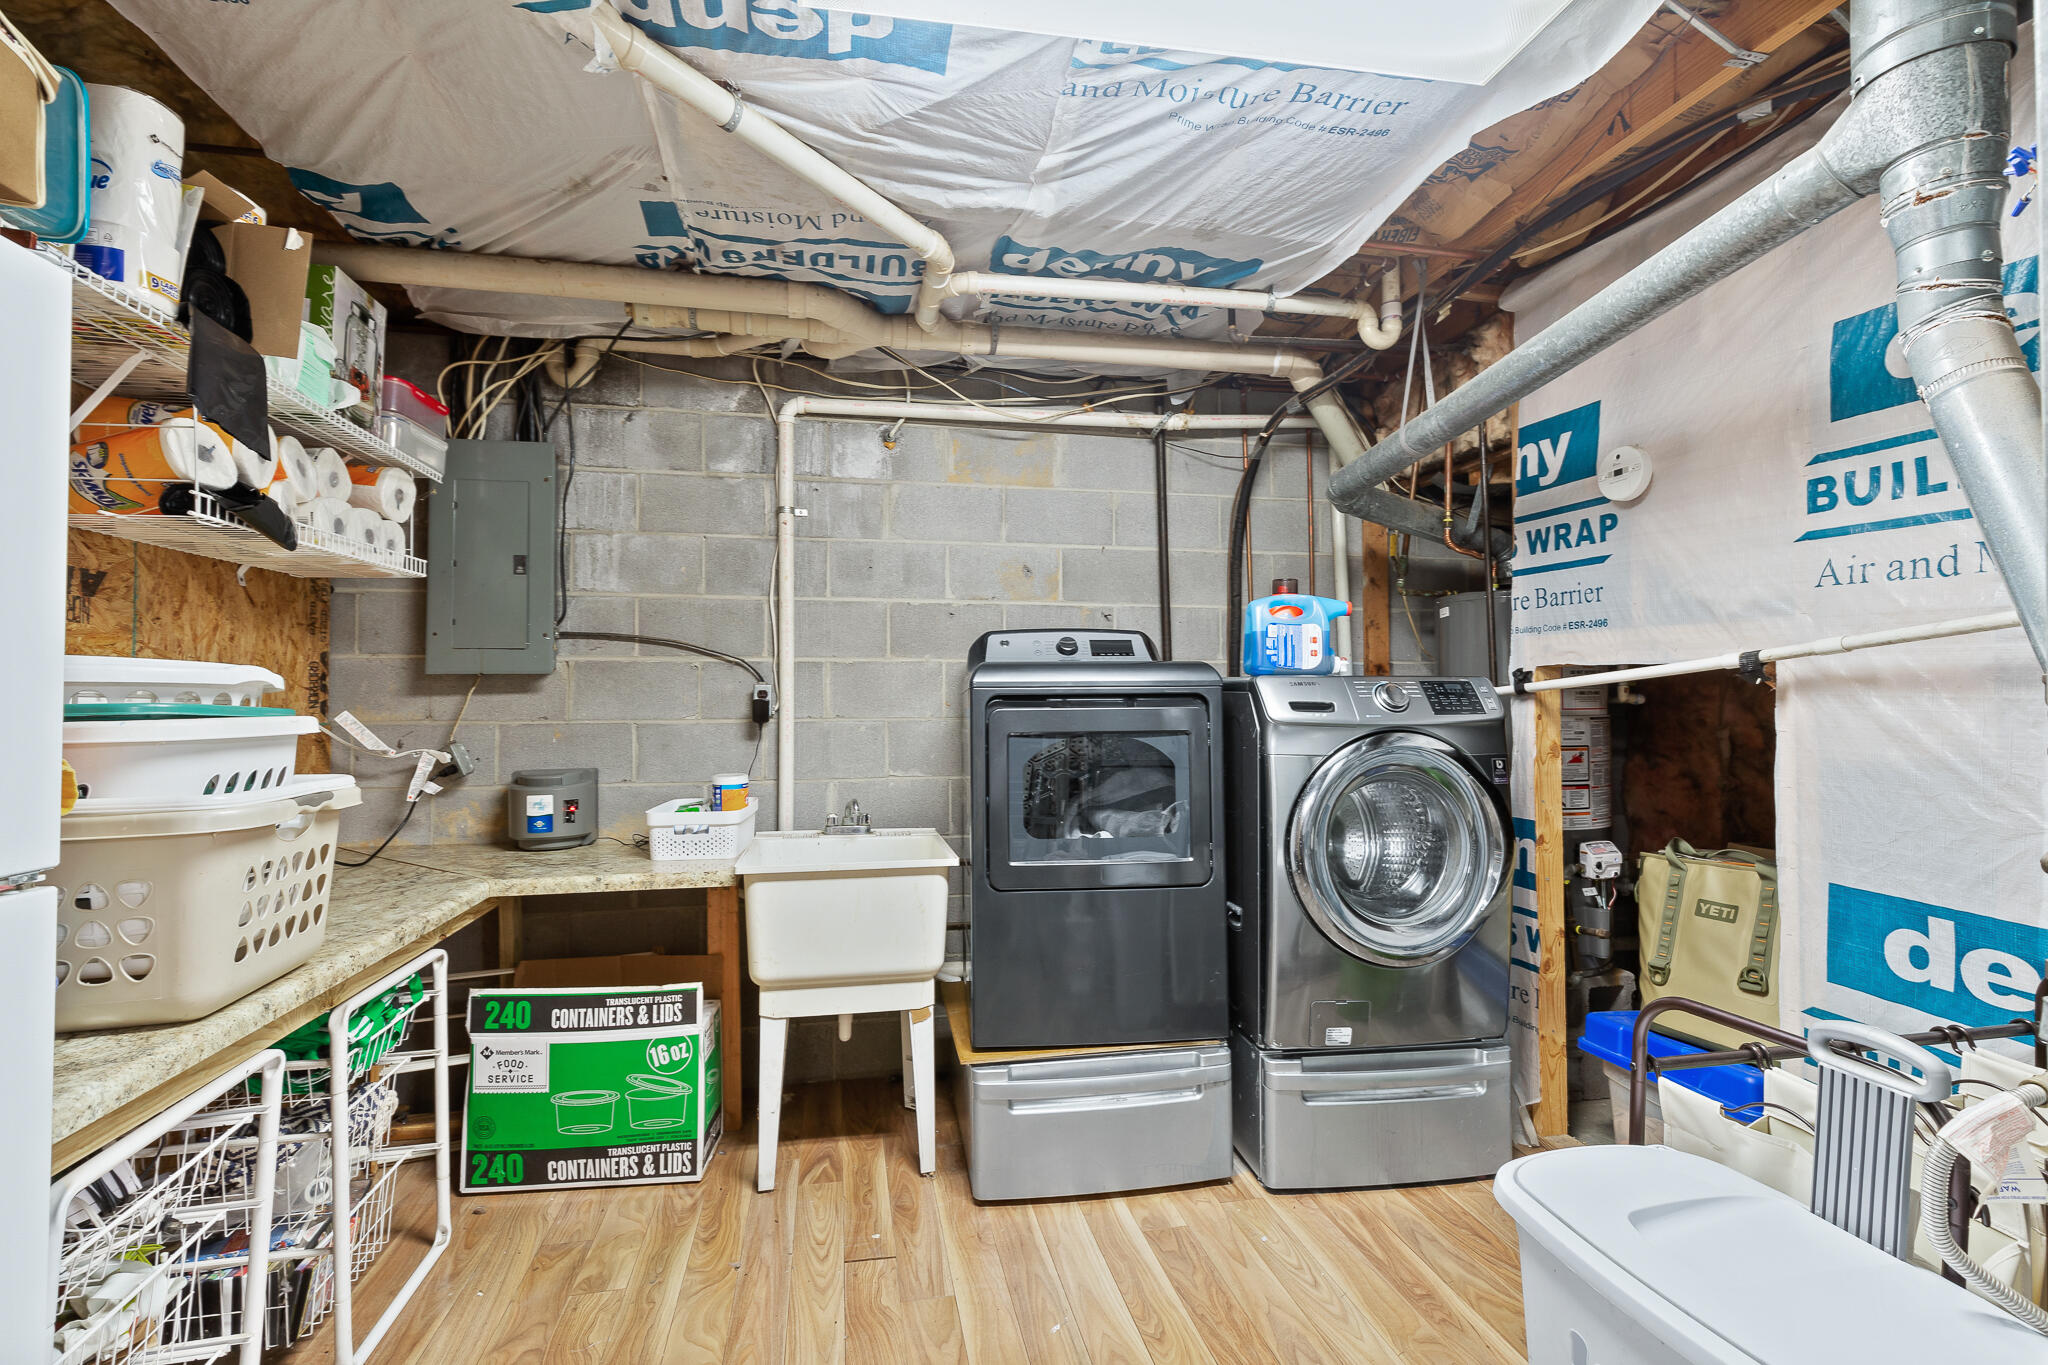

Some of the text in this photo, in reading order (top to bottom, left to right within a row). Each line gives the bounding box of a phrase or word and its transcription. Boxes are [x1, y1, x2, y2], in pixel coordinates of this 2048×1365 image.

[1289, 81, 1410, 116] Barrier
[1328, 126, 1391, 137] ESR-2496
[695, 209, 824, 231] Moisture
[1807, 455, 1962, 515] BUIL
[1526, 513, 1618, 556] WRAP
[1815, 555, 1875, 588] Air
[1886, 544, 1961, 582] and
[1535, 582, 1604, 609] Barrier
[1568, 618, 1608, 630] ESR-2496
[1700, 902, 1735, 920] YETI
[1884, 916, 2042, 1013] de
[605, 995, 683, 1006] TRANSLUCENT PLASTIC
[484, 1001, 683, 1030] 240 CONTAINERS & LIDS
[497, 1059, 525, 1070] FOOD
[649, 1044, 670, 1067] 16
[488, 1074, 534, 1084] SERVICE
[608, 1142, 692, 1157] TRANSLUCENT PLASTIC
[471, 1151, 692, 1184] 240 CONTAINERS & LIDS
